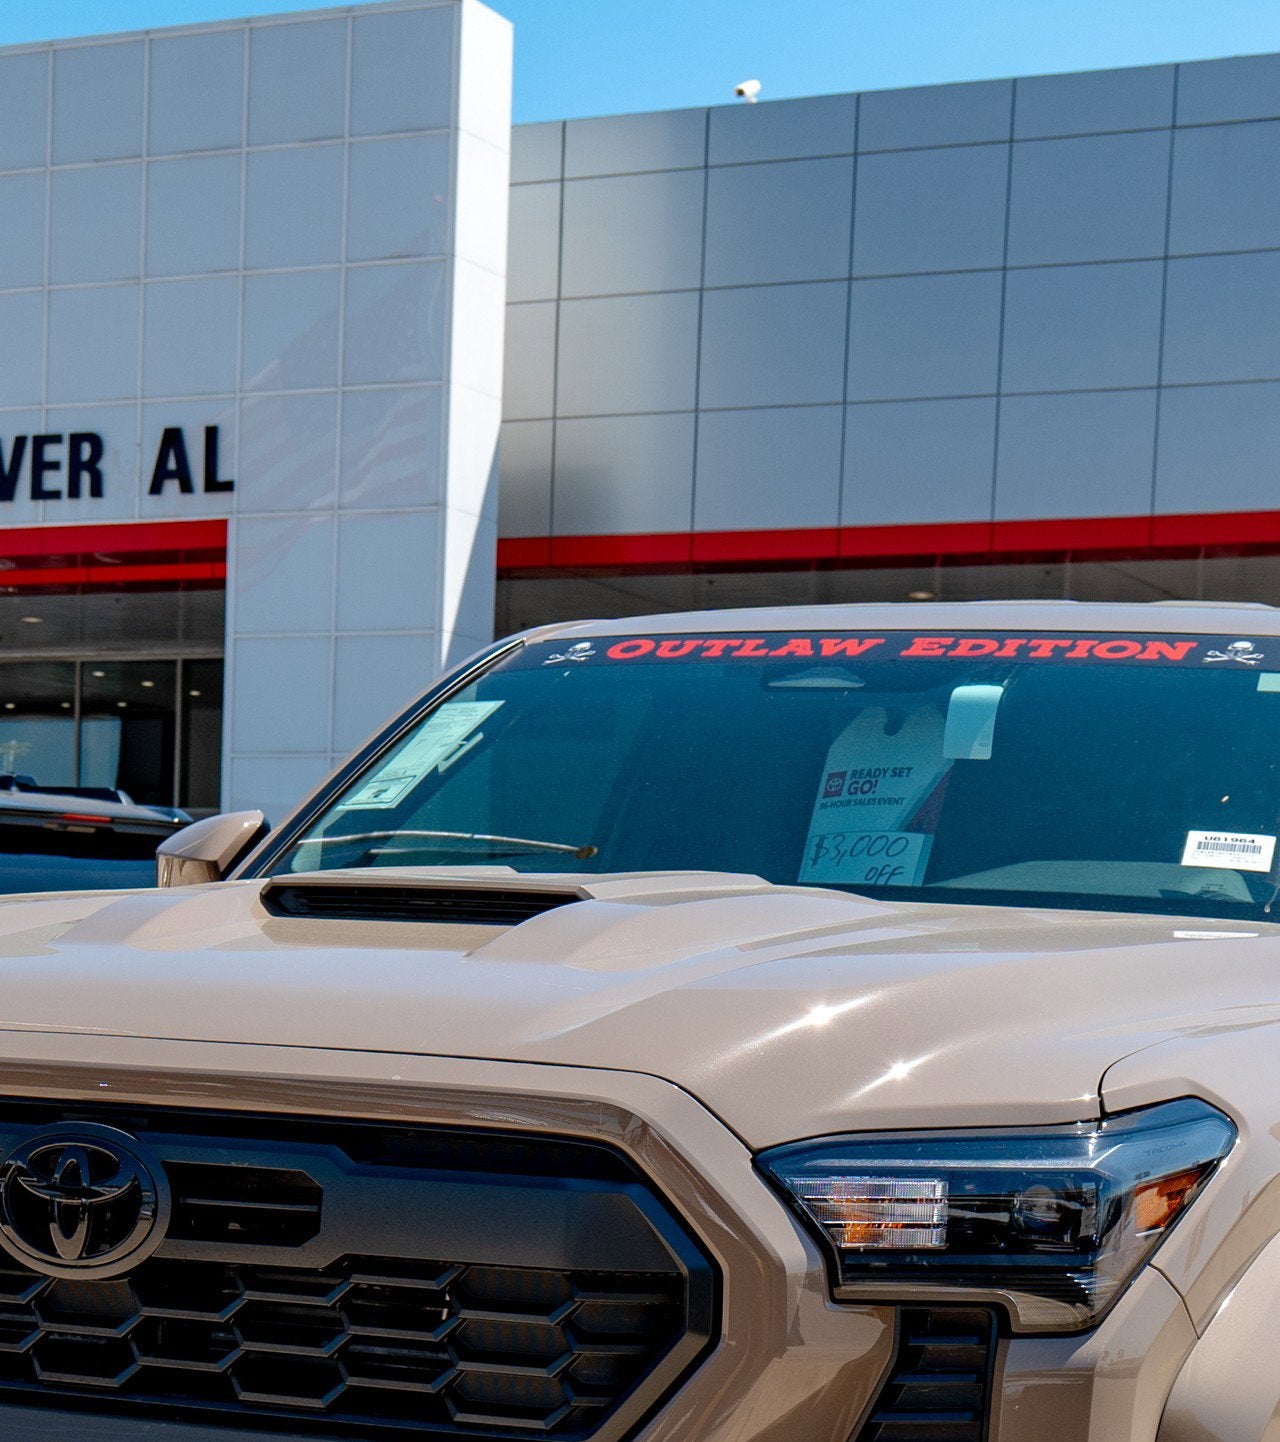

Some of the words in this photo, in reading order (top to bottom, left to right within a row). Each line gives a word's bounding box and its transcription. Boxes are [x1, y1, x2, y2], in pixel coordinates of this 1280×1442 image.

[606, 638, 886, 660] OUTLAW
[899, 637, 1198, 661] EDITION
[851, 768, 889, 779] READY
[890, 767, 913, 778] SET
[847, 779, 879, 795] GO!
[853, 798, 877, 807] SALES
[878, 797, 905, 806] EVENT
[810, 833, 910, 868] $3,000
